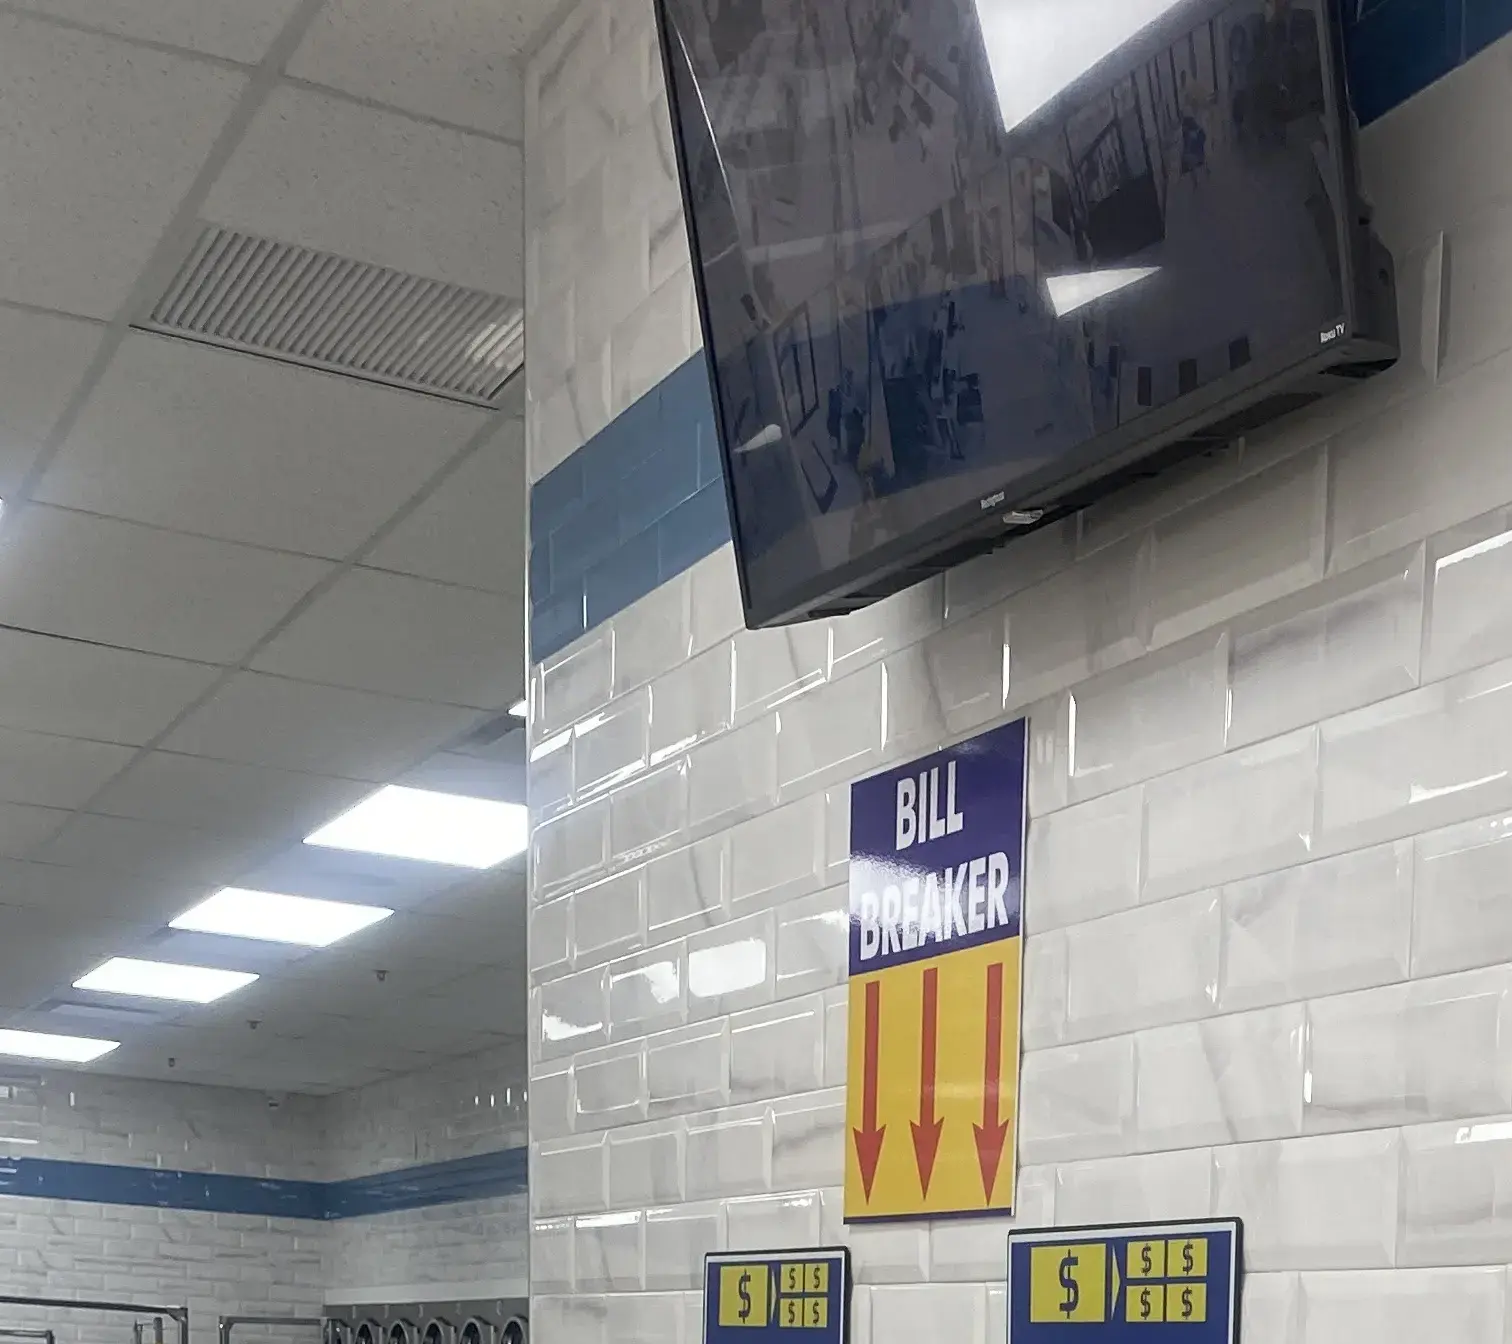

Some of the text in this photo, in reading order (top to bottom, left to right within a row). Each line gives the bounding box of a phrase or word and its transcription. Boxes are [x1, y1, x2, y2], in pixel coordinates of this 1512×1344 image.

[1335, 322, 1345, 337] TV
[895, 760, 963, 850] BILL
[859, 852, 1010, 962] BREAKER
[738, 1268, 751, 1324] $
[1059, 1249, 1079, 1319] $
